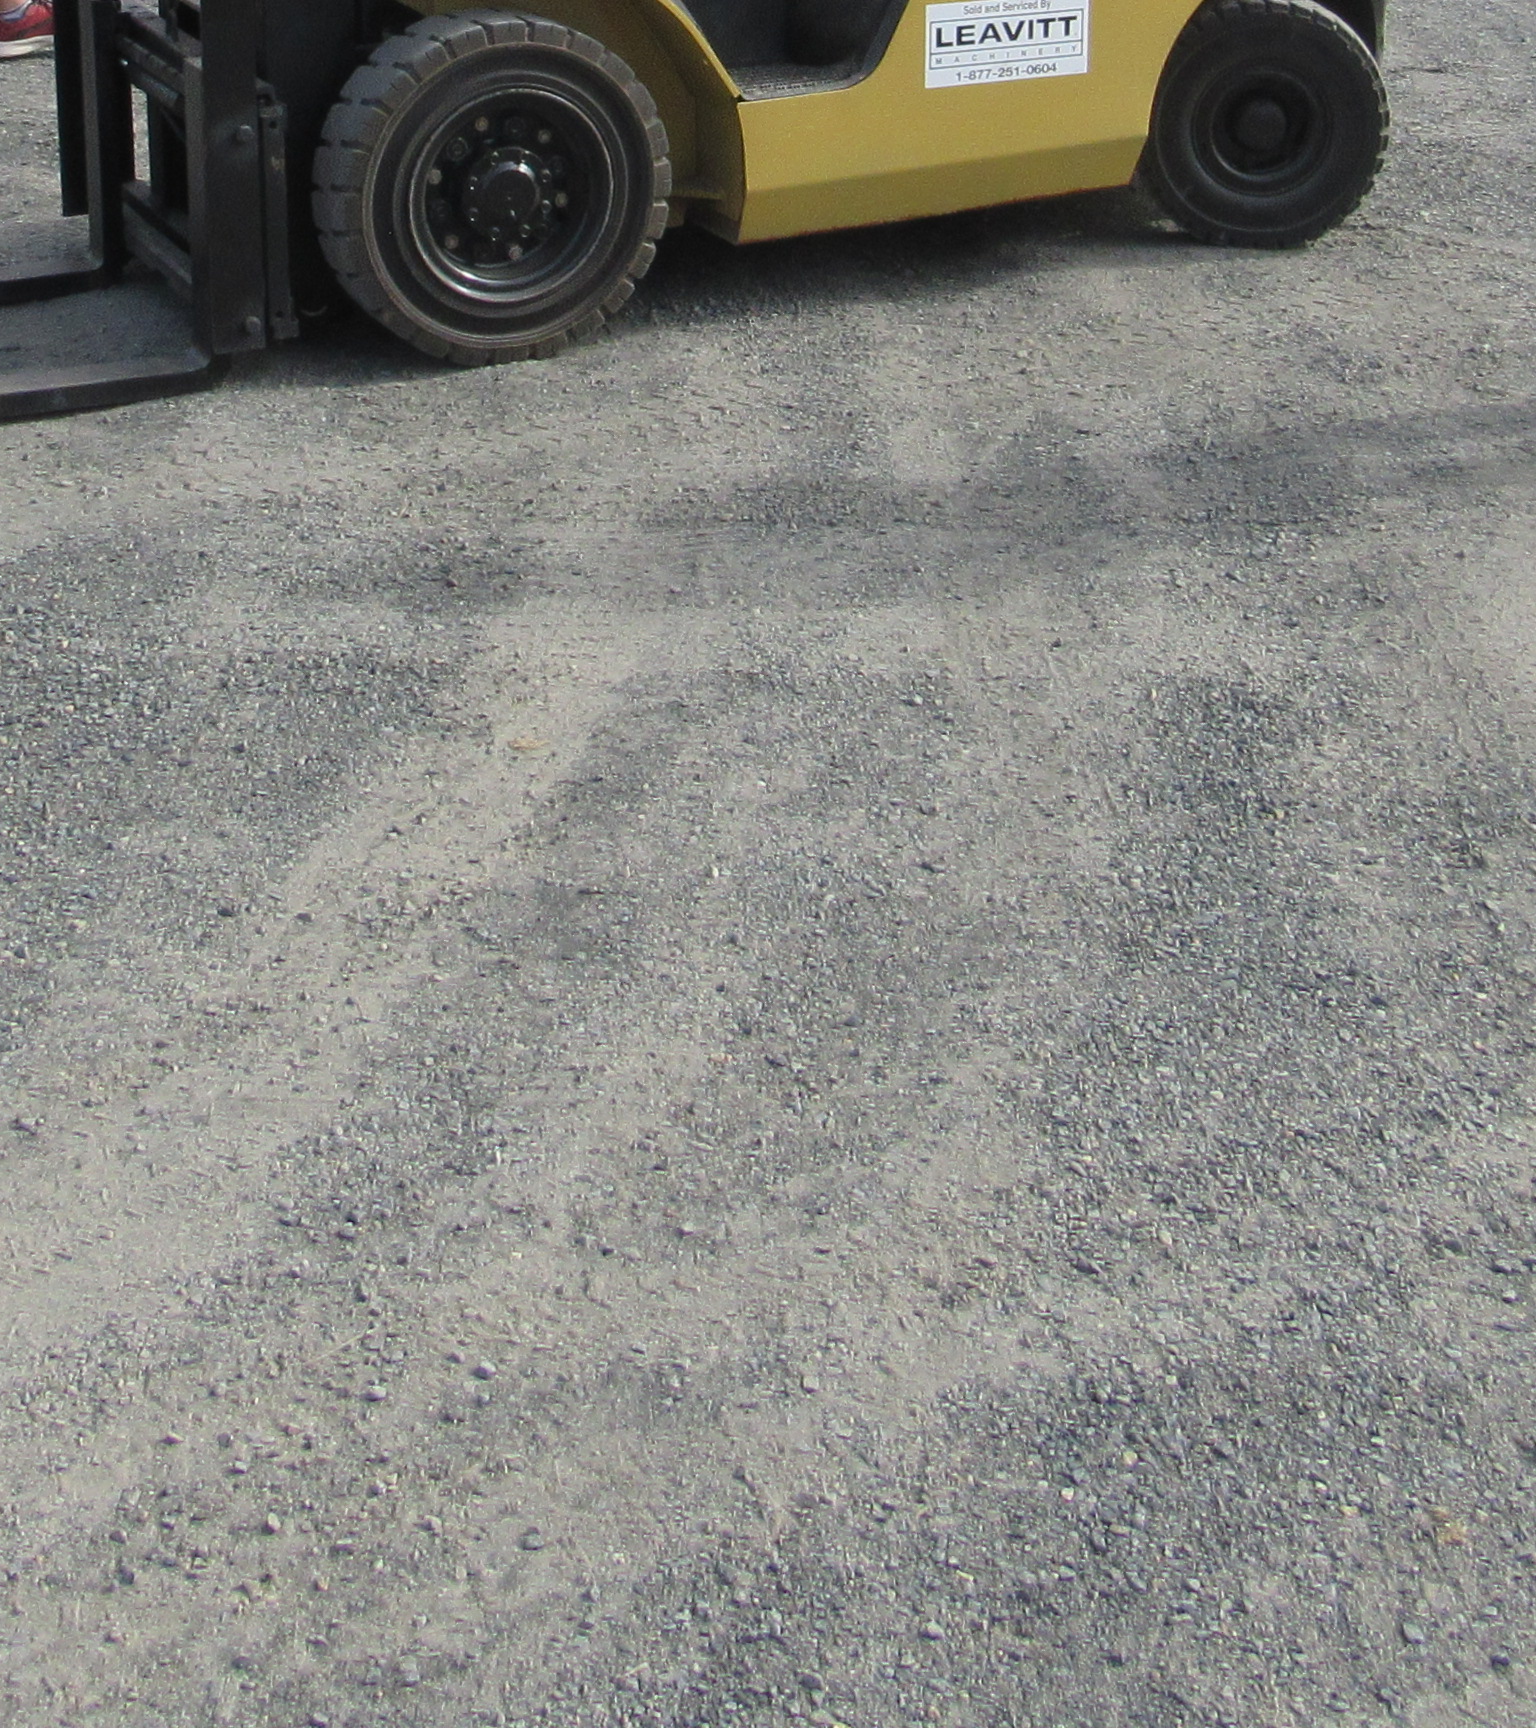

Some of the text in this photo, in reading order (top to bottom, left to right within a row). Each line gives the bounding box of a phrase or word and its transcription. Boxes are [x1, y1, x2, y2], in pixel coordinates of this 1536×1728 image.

[964, 0, 1051, 15] Sold and Serviced By
[935, 15, 1077, 48] LEAVITT
[935, 45, 1077, 65] MACHINERY
[955, 62, 1057, 82] 1-877-251-0604
